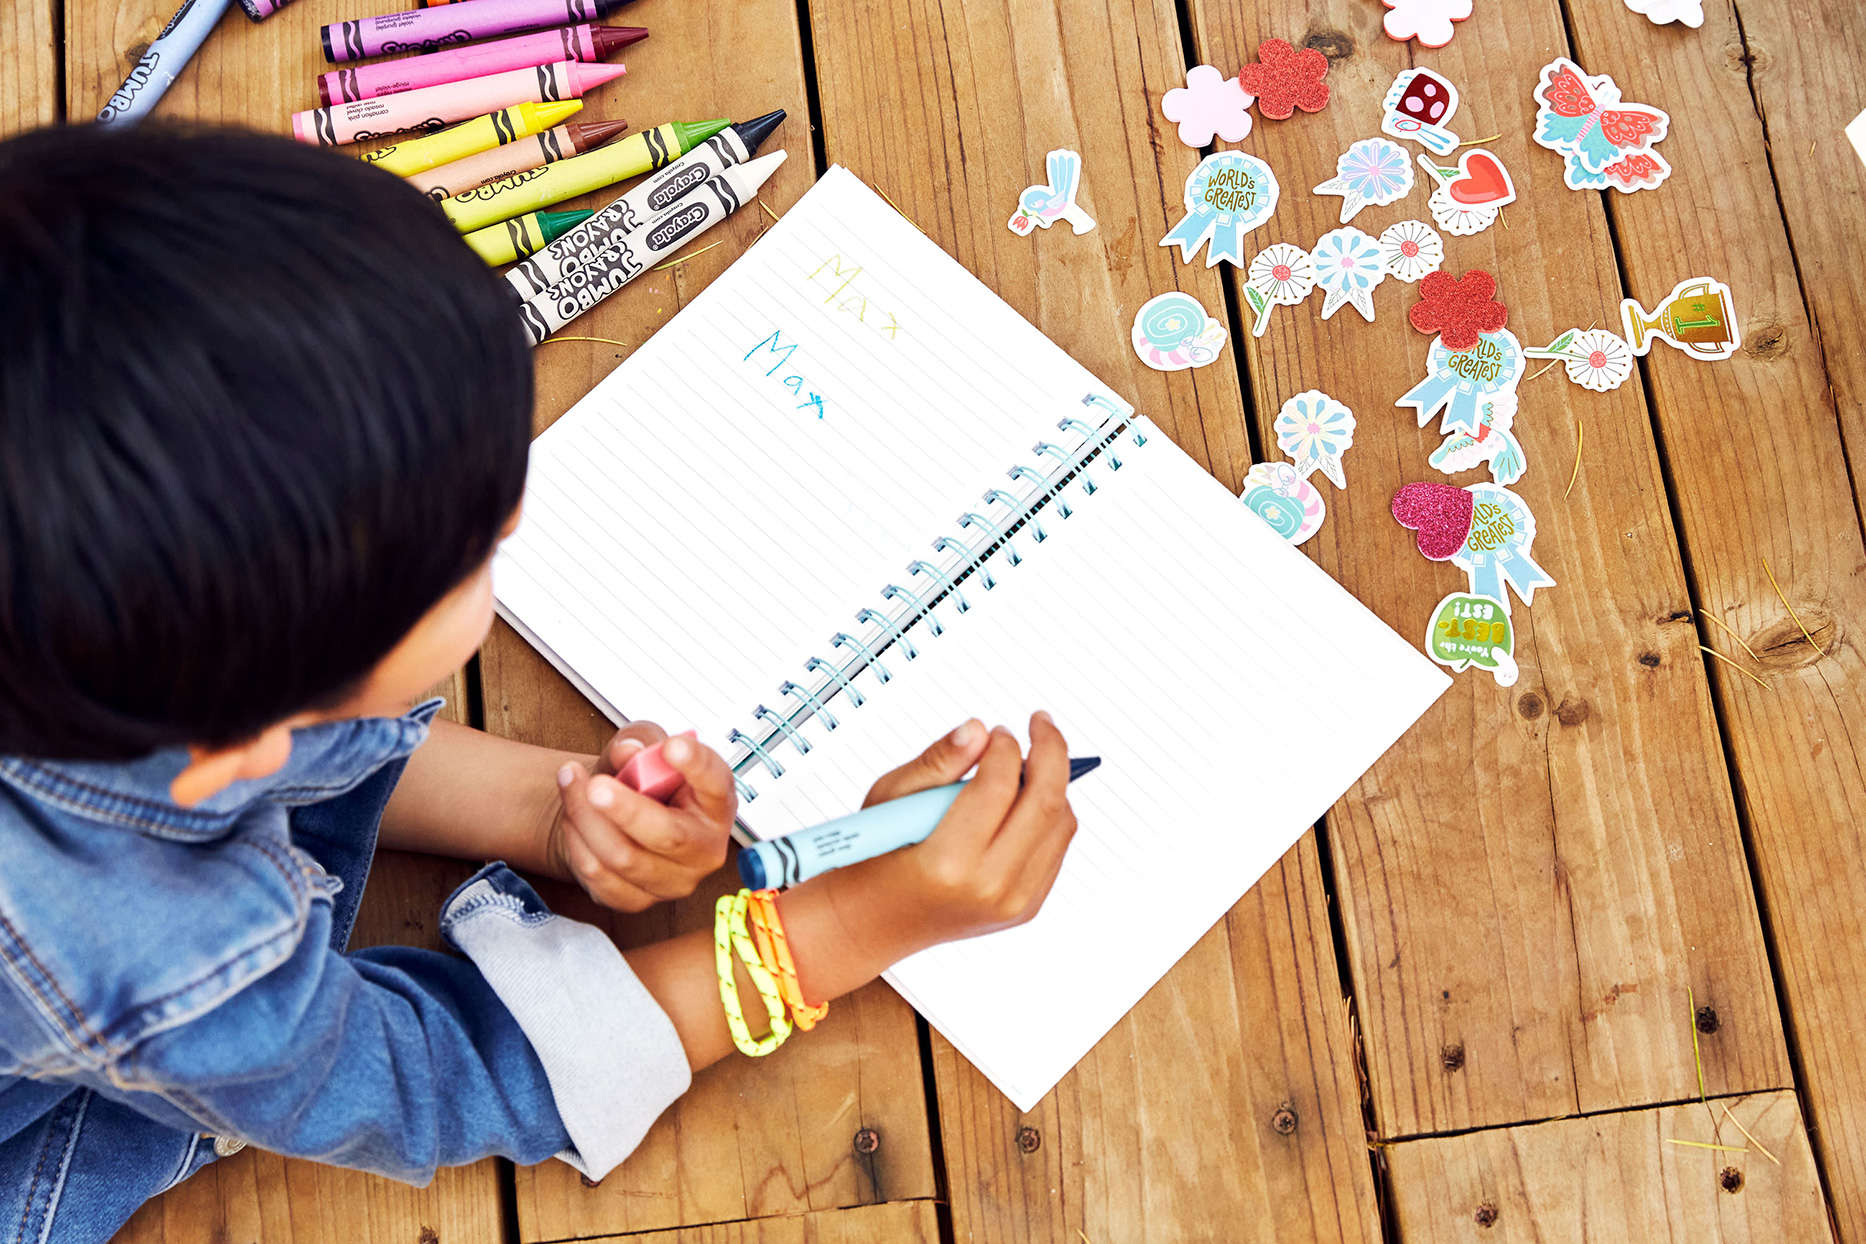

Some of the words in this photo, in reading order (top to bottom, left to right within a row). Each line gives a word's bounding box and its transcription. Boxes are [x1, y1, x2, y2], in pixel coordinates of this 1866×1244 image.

[547, 199, 630, 262] CRAYONS
[546, 241, 628, 301] CRAYONS
[557, 249, 644, 320] JUMBO
[806, 254, 902, 340] Max
[1675, 303, 1720, 334] #1
[743, 329, 829, 420] Max
[1454, 601, 1494, 621] EST!
